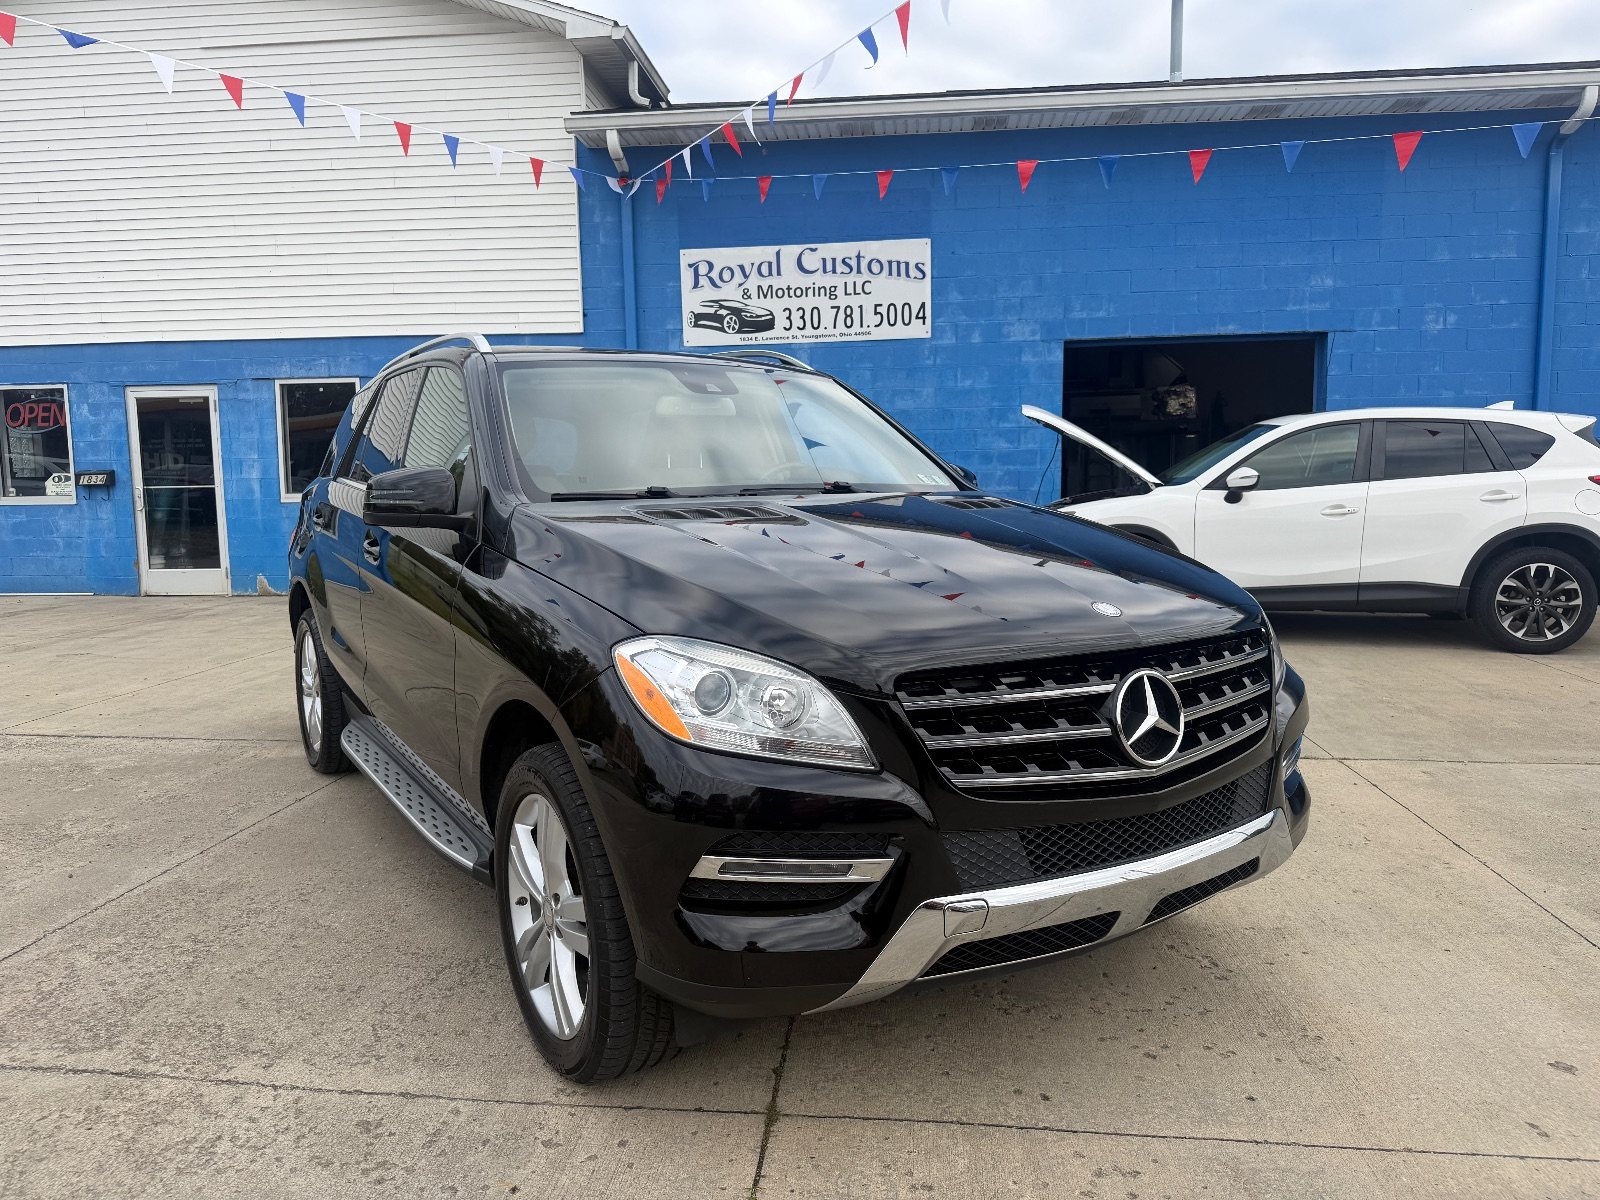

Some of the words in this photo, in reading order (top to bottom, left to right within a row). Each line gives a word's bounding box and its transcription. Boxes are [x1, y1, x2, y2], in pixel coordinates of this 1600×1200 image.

[687, 248, 782, 290] Royal
[796, 247, 927, 281] Customs
[741, 288, 753, 300] &
[757, 282, 838, 300] Motoring
[844, 280, 872, 296] LLC
[782, 301, 927, 331] 330.781.5004
[6, 402, 66, 428] OPEN
[81, 475, 106, 484] 1834
